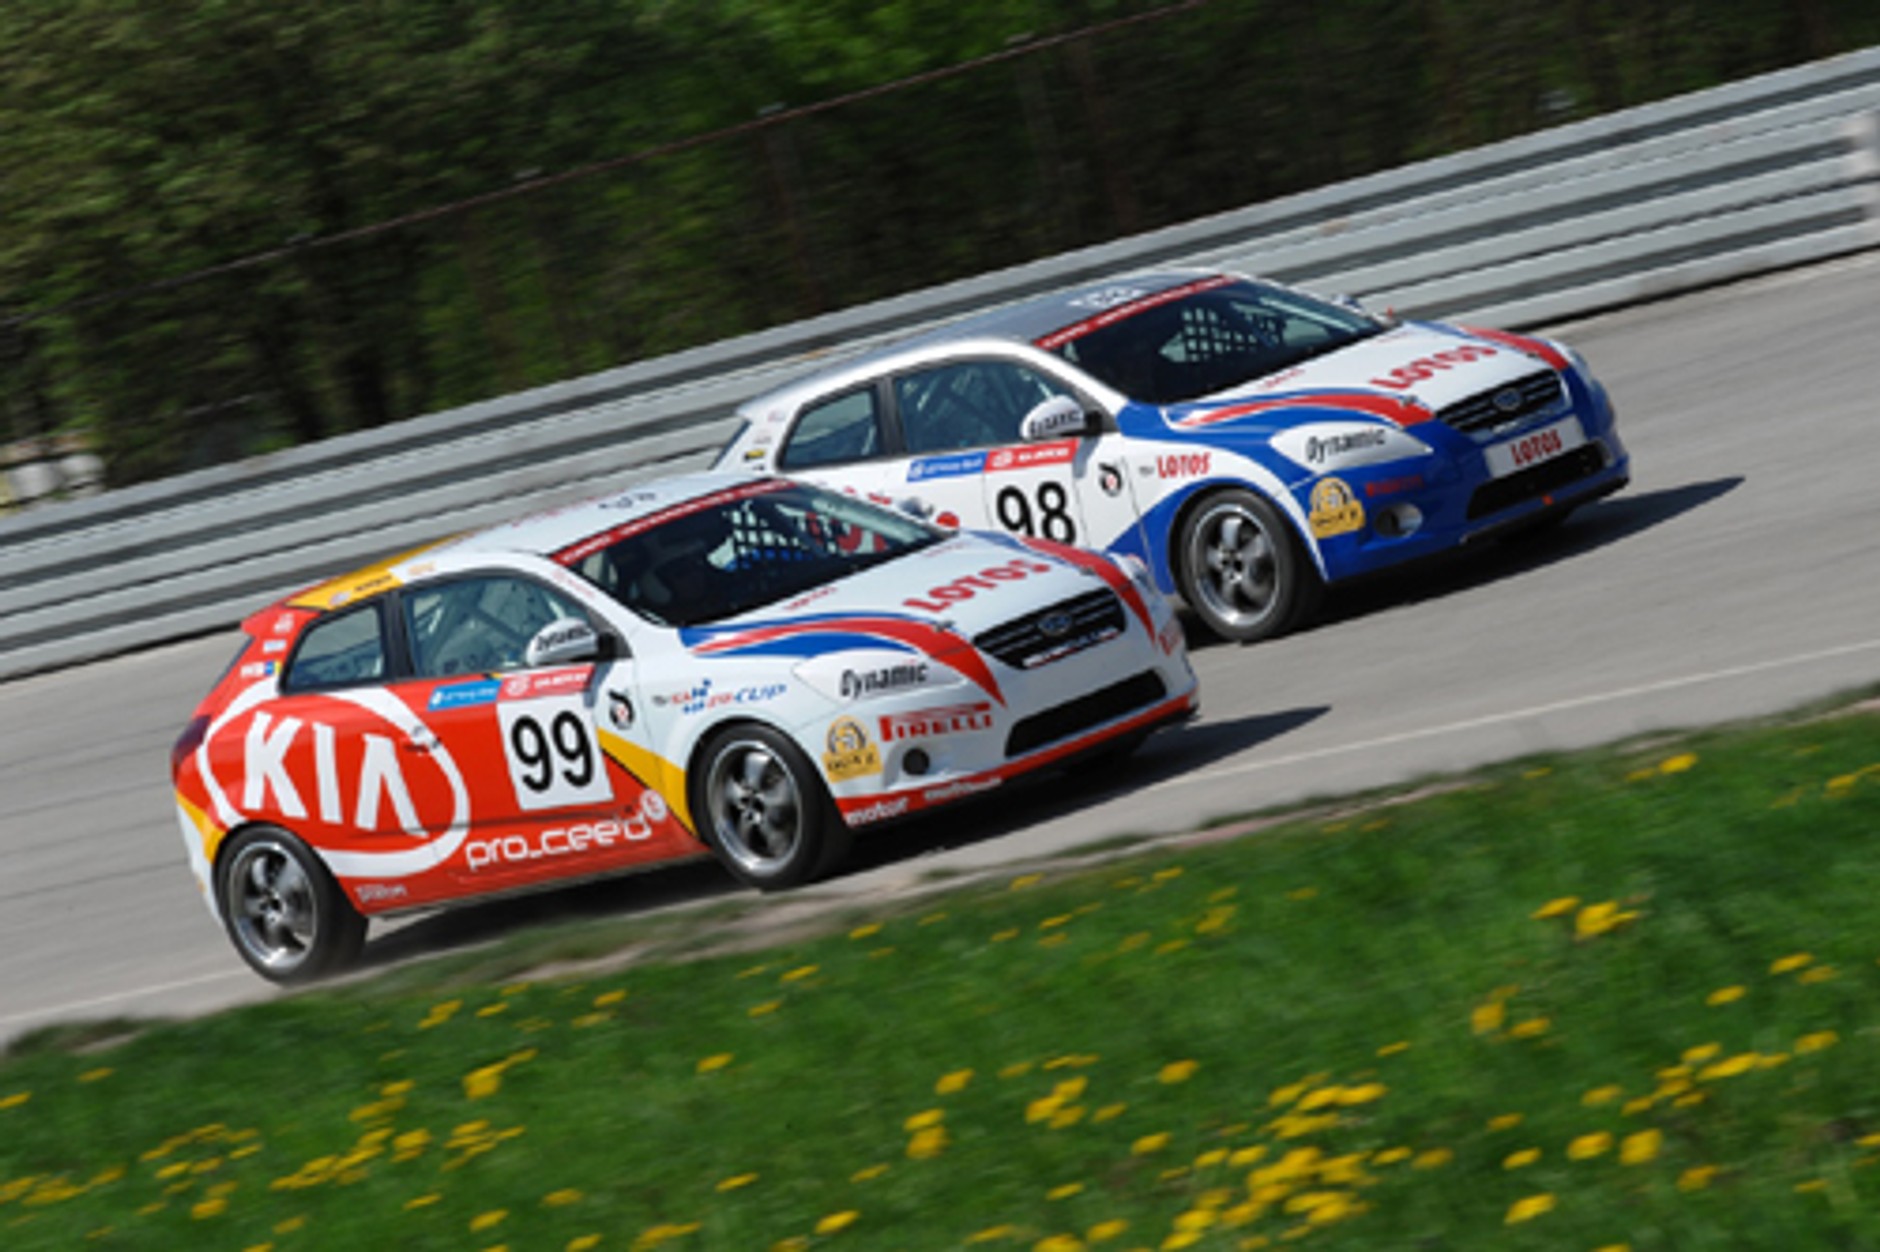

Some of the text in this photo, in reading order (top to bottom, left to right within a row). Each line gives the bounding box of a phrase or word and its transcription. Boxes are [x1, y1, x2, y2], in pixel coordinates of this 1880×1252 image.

[1369, 345, 1497, 391] LOTOS
[1157, 452, 1212, 479] LOTOS
[1306, 428, 1386, 464] Dynamic
[1511, 428, 1563, 466] LOTOS
[996, 480, 1077, 545] 98
[902, 559, 1051, 614] LOTOS
[840, 661, 928, 699] Dynamic
[878, 701, 993, 743] PIRELLI
[510, 709, 594, 793] 99
[242, 711, 431, 838] KIA
